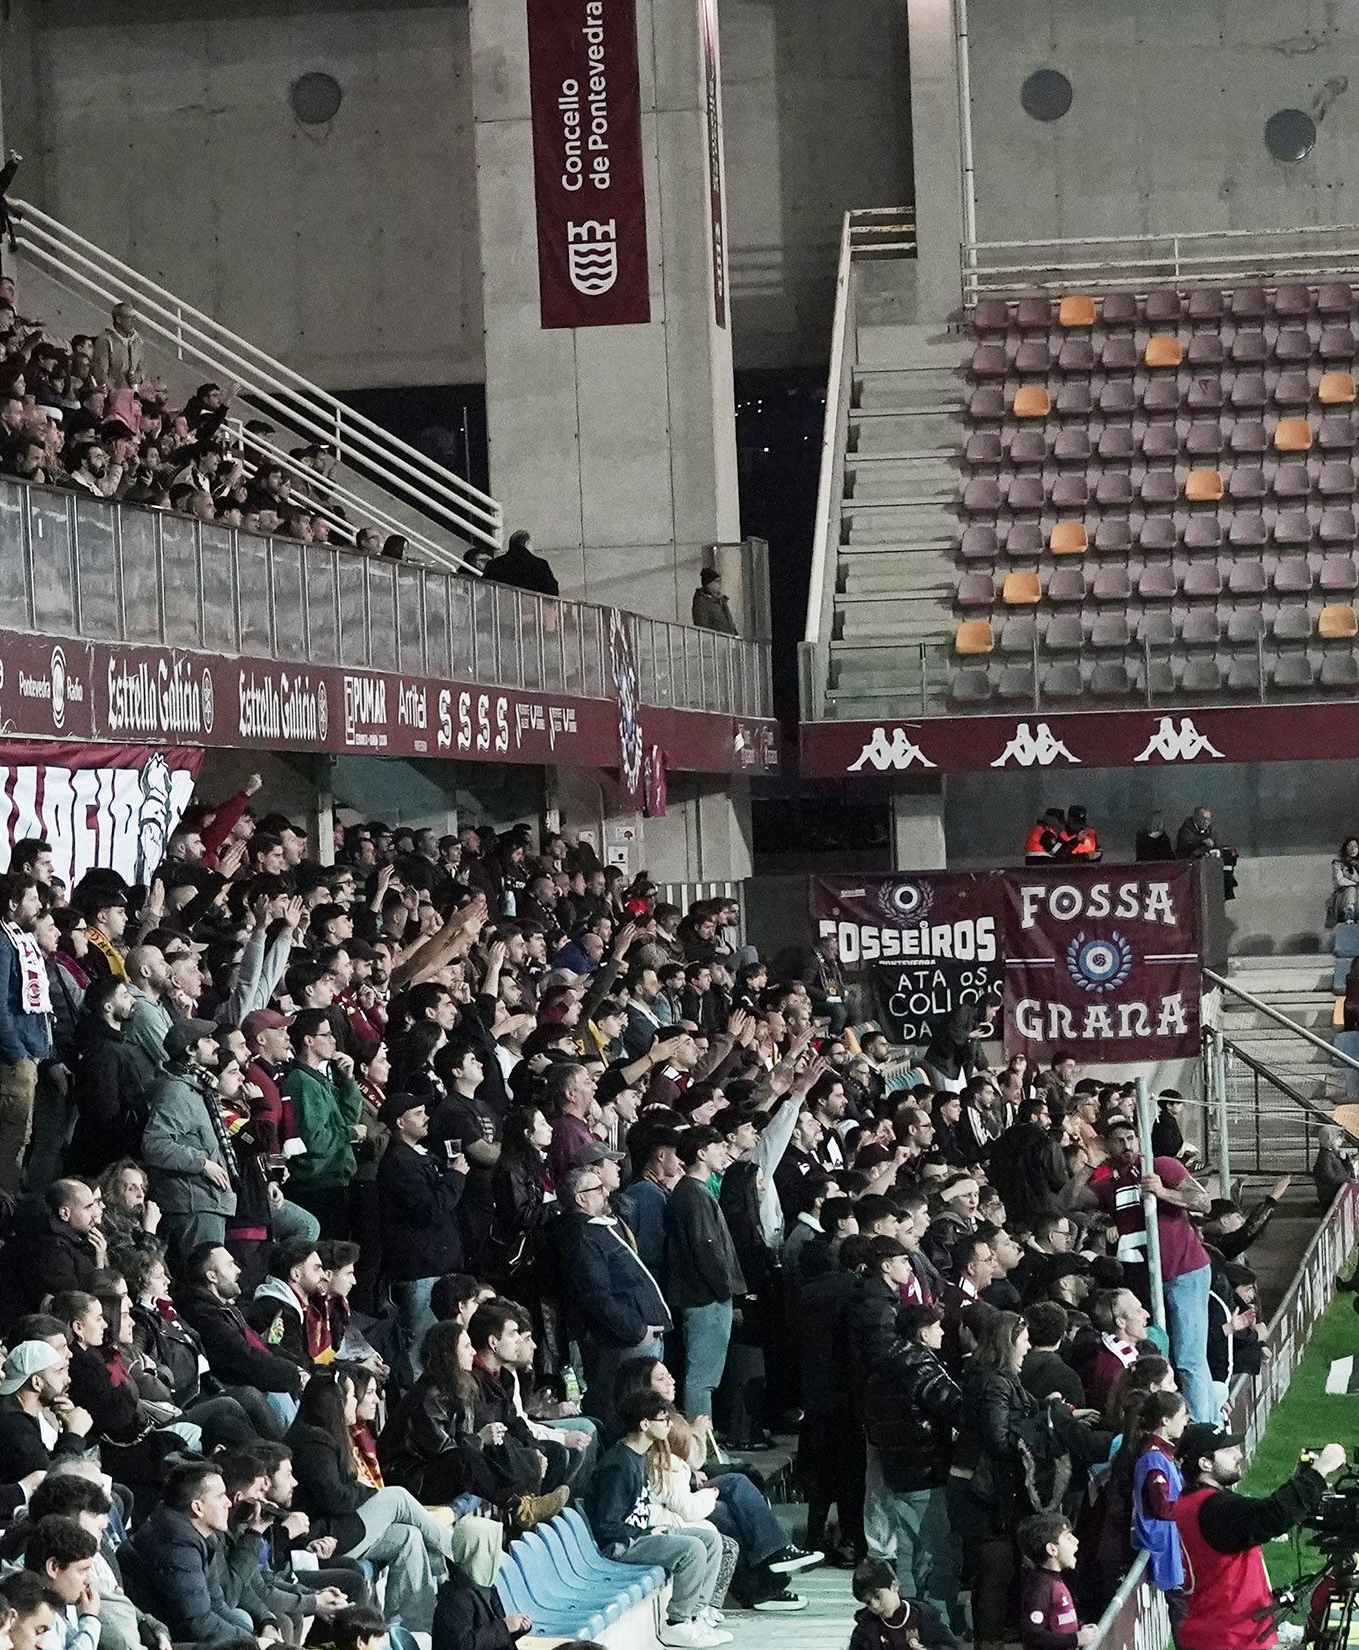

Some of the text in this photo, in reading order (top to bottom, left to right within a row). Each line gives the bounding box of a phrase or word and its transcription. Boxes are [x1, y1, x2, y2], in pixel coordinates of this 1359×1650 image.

[582, 1, 610, 189] de Pontevedra
[558, 79, 583, 191] Concello
[108, 656, 200, 732] Estrella Galicia
[1020, 882, 1177, 930] FOSSA
[898, 969, 947, 991] ATA
[904, 1020, 933, 1040] DA
[1015, 992, 1188, 1041] GRANA
